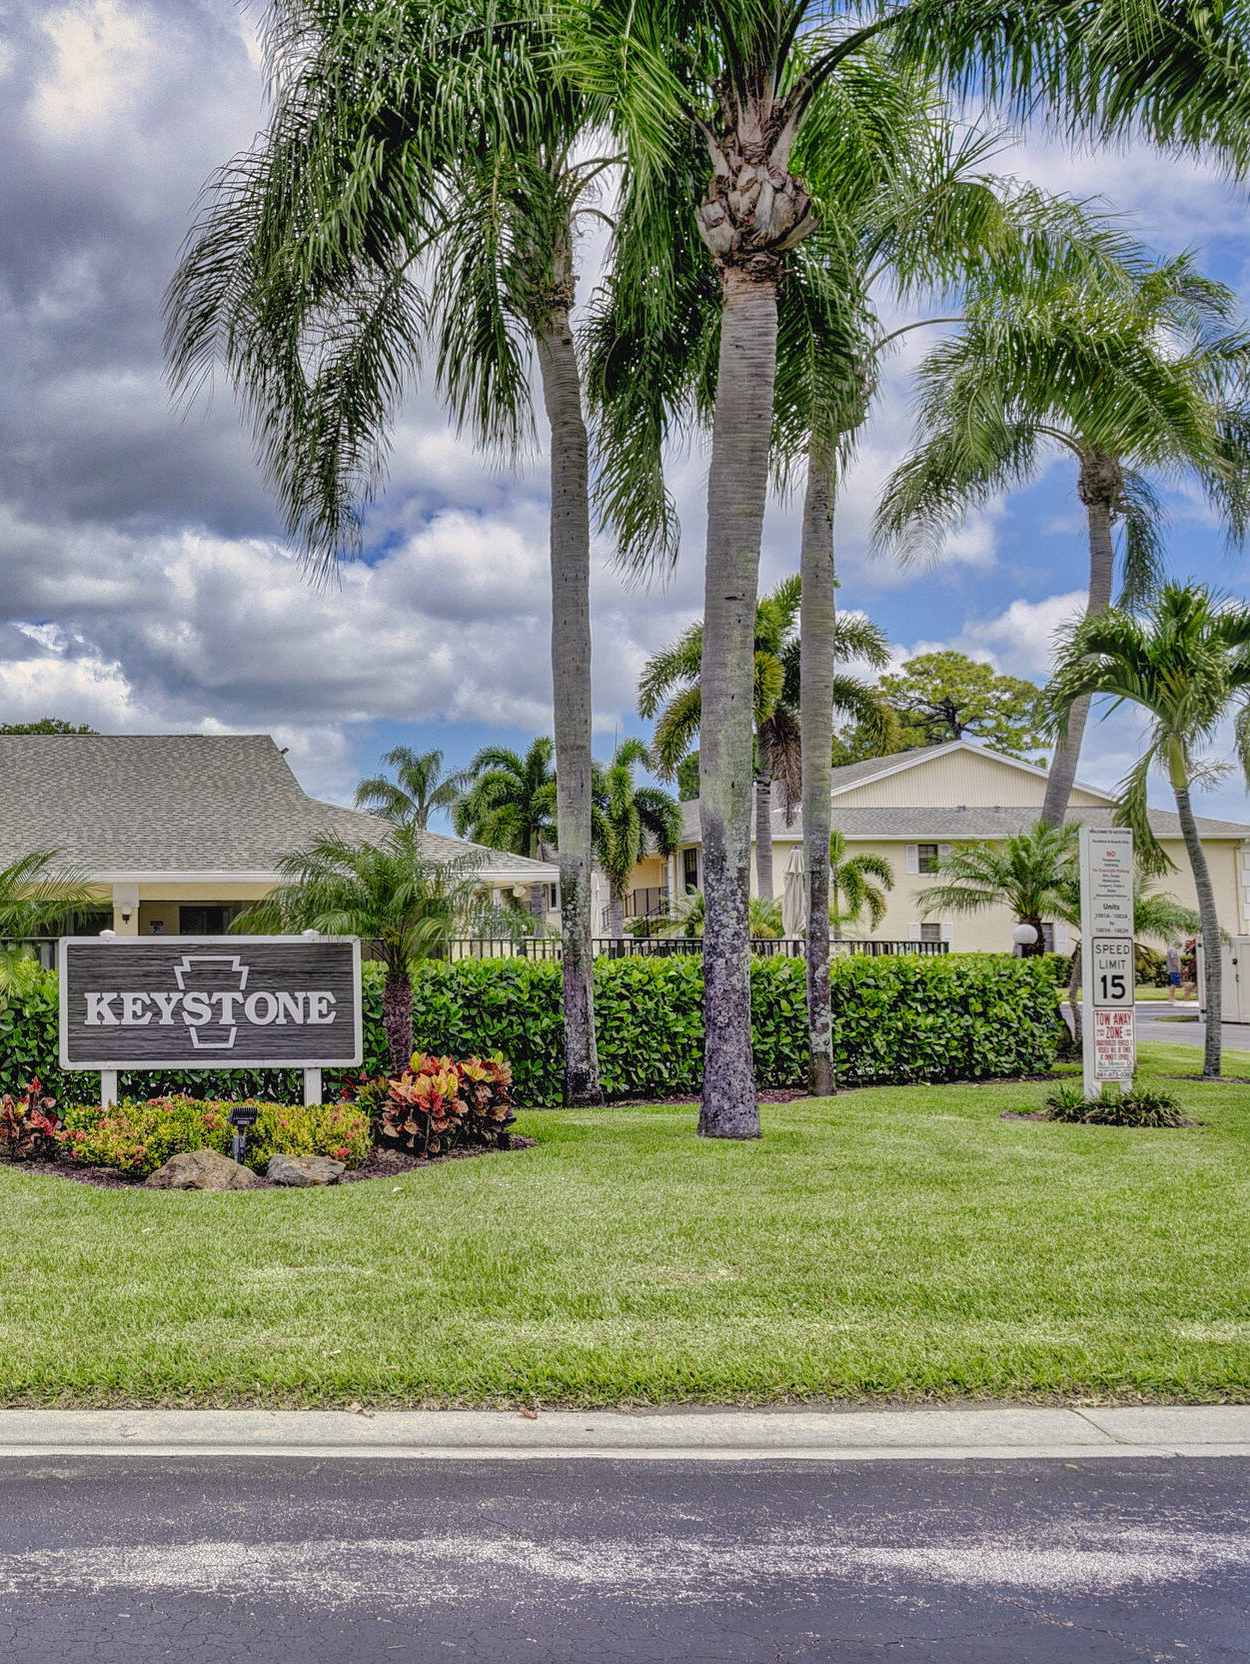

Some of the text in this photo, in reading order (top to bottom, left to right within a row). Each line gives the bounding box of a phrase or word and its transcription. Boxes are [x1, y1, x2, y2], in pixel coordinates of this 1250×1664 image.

[1095, 944, 1130, 955] SPEED
[1099, 959, 1126, 970] LIMIT
[1100, 974, 1126, 1000] 15
[84, 991, 337, 1026] KEYSTONE
[1095, 1013, 1131, 1025] TOW AWAY
[1106, 1026, 1123, 1038] ZONE
